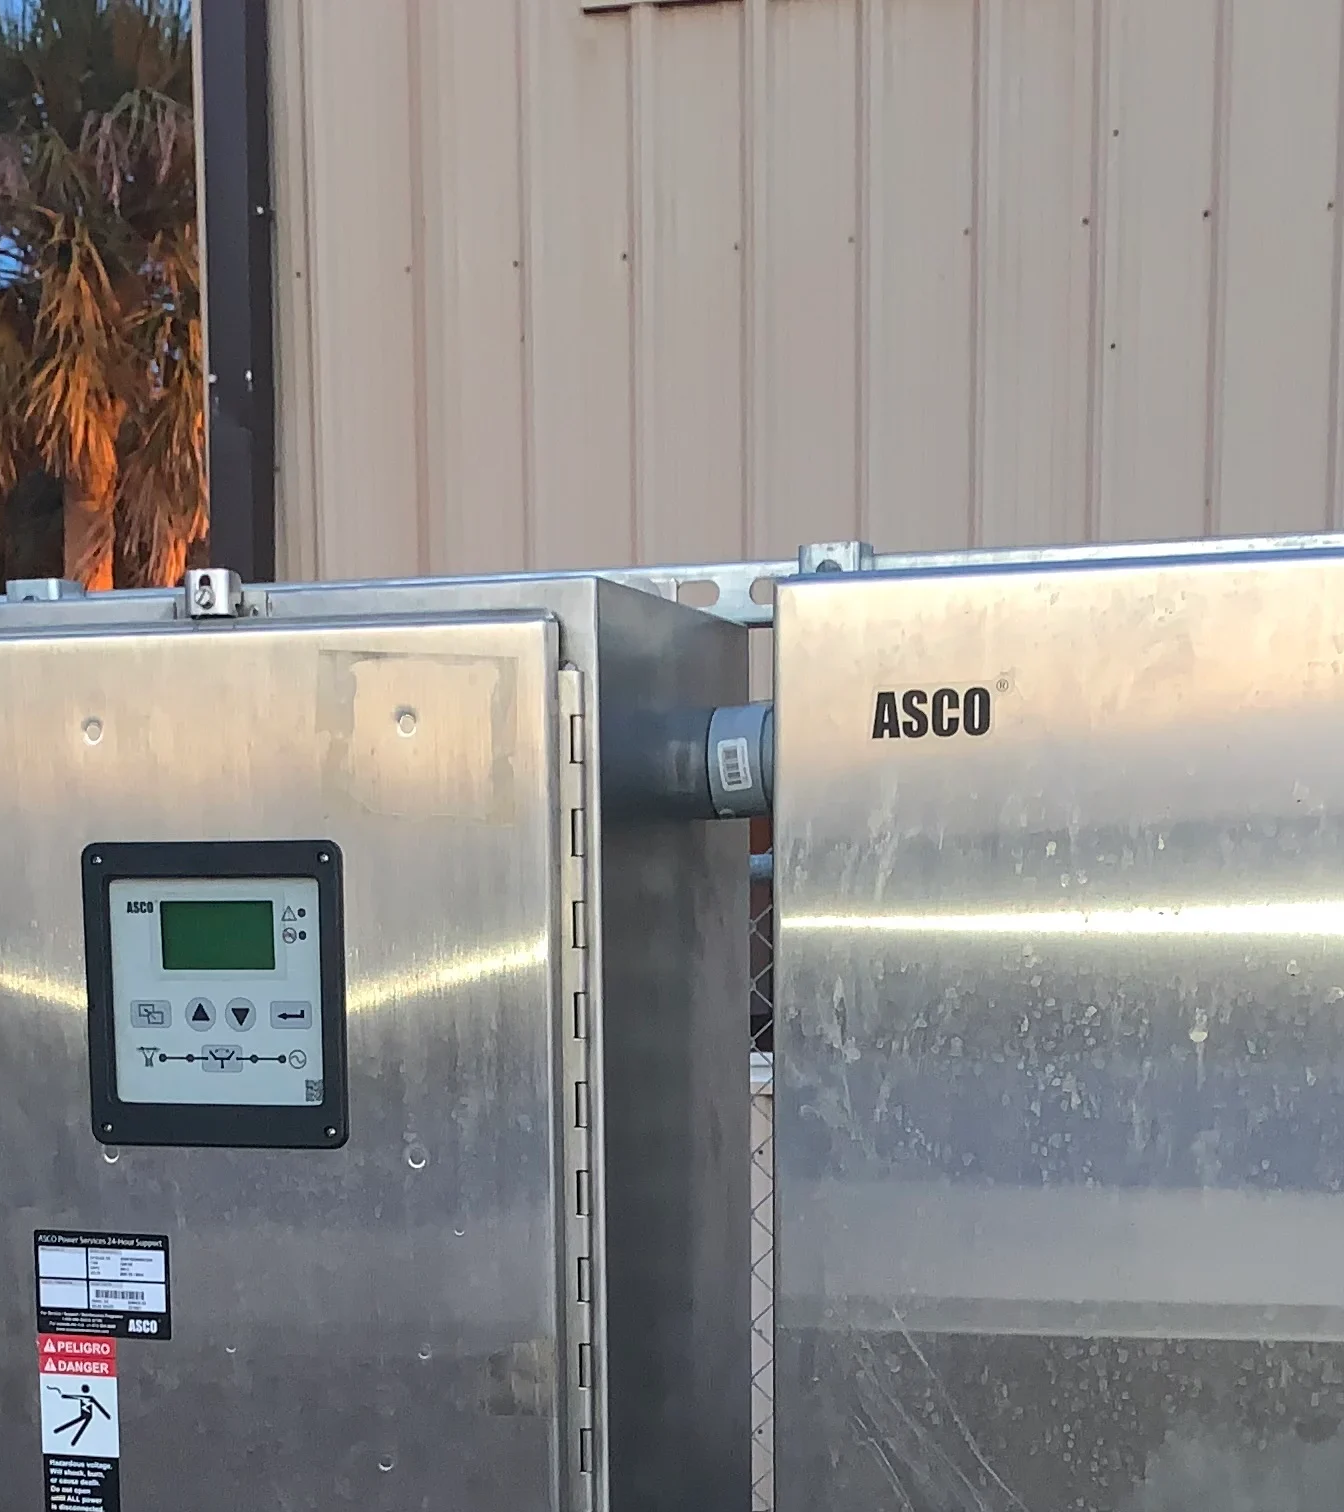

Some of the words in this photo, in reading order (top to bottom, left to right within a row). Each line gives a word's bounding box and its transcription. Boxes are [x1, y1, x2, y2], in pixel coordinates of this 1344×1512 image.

[872, 687, 991, 738] ASCO
[126, 901, 154, 914] ASCO
[38, 1235, 57, 1243] ASCO
[58, 1236, 78, 1244] Power
[136, 1239, 162, 1248] Support
[128, 1319, 158, 1333] ASCO
[57, 1340, 110, 1354] PELIGRO
[58, 1361, 109, 1374] DANGER
